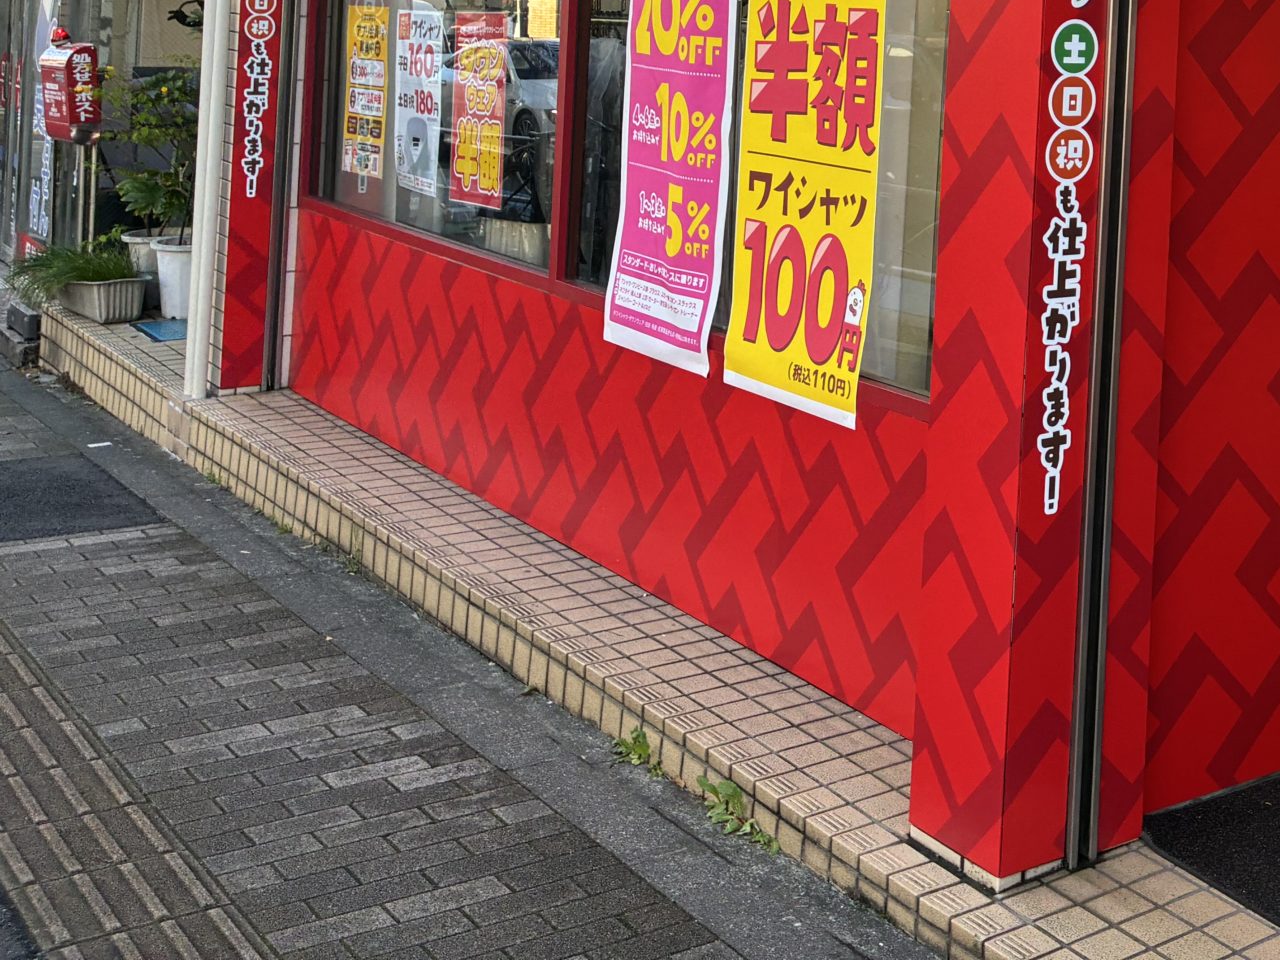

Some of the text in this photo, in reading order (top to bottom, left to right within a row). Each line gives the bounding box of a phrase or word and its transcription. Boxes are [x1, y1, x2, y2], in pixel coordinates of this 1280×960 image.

[411, 19, 442, 39] ワイシャツ
[458, 40, 505, 83] ダウン
[678, 35, 723, 66] OFF
[465, 84, 498, 116] ウェア
[655, 81, 717, 162] 10%
[453, 117, 502, 197] 半額
[686, 152, 717, 169] OFF
[747, 170, 868, 228] ワイシャツ
[665, 182, 711, 258] 5%
[684, 242, 710, 259] OFF
[1040, 18, 1098, 517] 土日祝も仕上がります!
[787, 361, 852, 400] (税込110円)
